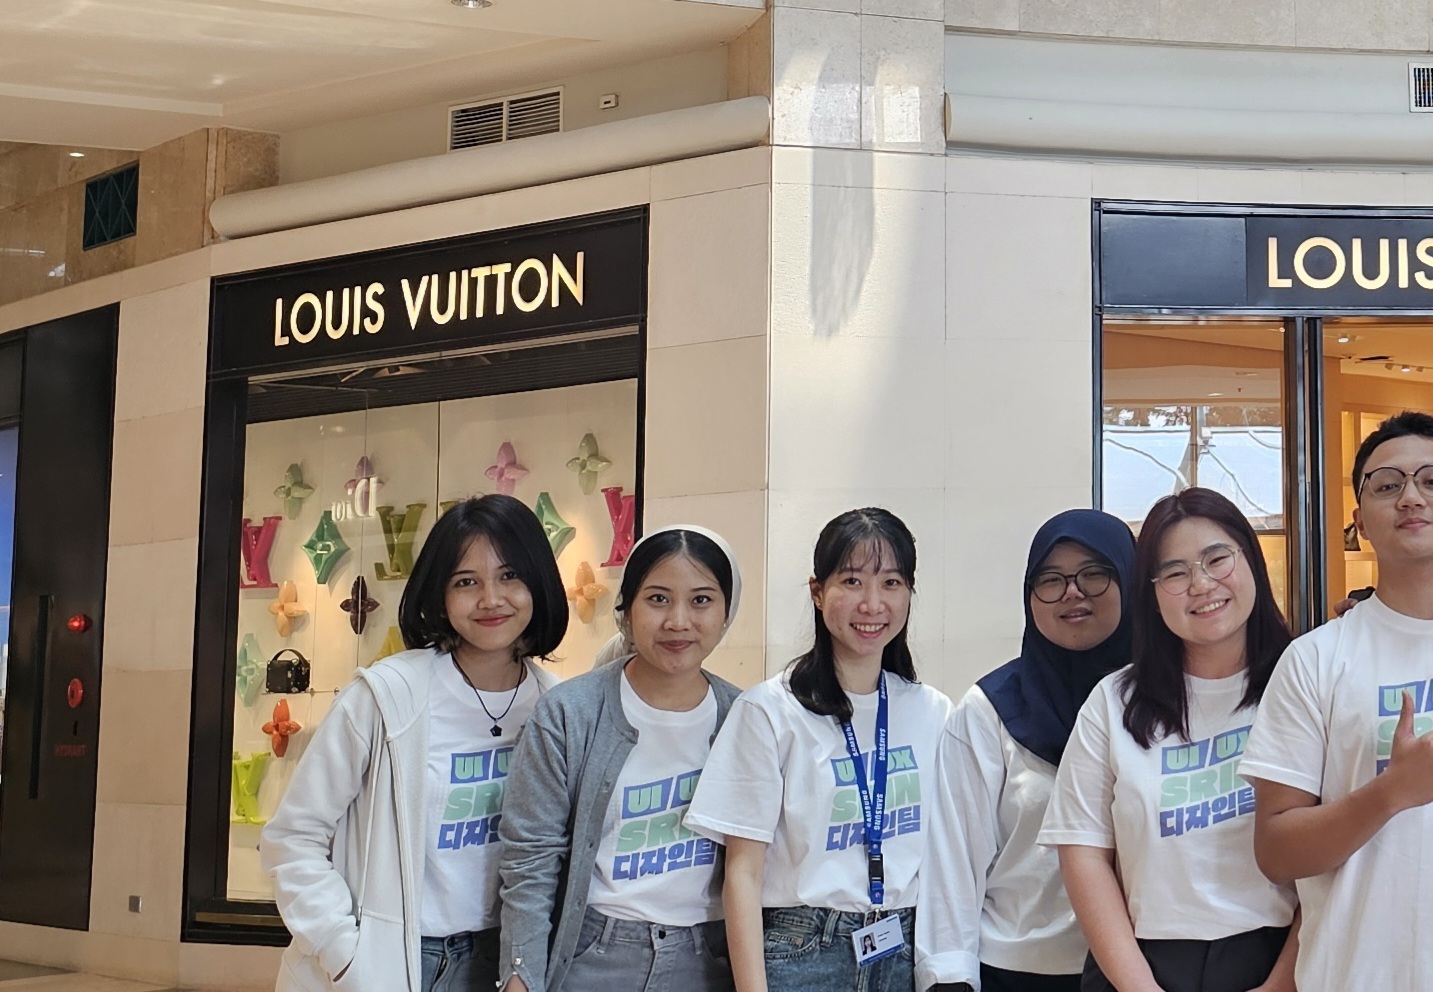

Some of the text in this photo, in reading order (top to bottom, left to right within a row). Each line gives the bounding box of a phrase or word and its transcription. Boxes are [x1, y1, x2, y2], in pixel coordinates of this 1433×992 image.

[274, 251, 585, 347] LOUIS VUITTON
[454, 755, 485, 780] UI
[1166, 744, 1200, 770] UI
[442, 782, 504, 821] SR
[628, 784, 662, 814] UI
[830, 772, 921, 823] SIN
[873, 792, 884, 832] SAMSUNG
[437, 814, 503, 851] 디자
[616, 808, 702, 852] SR
